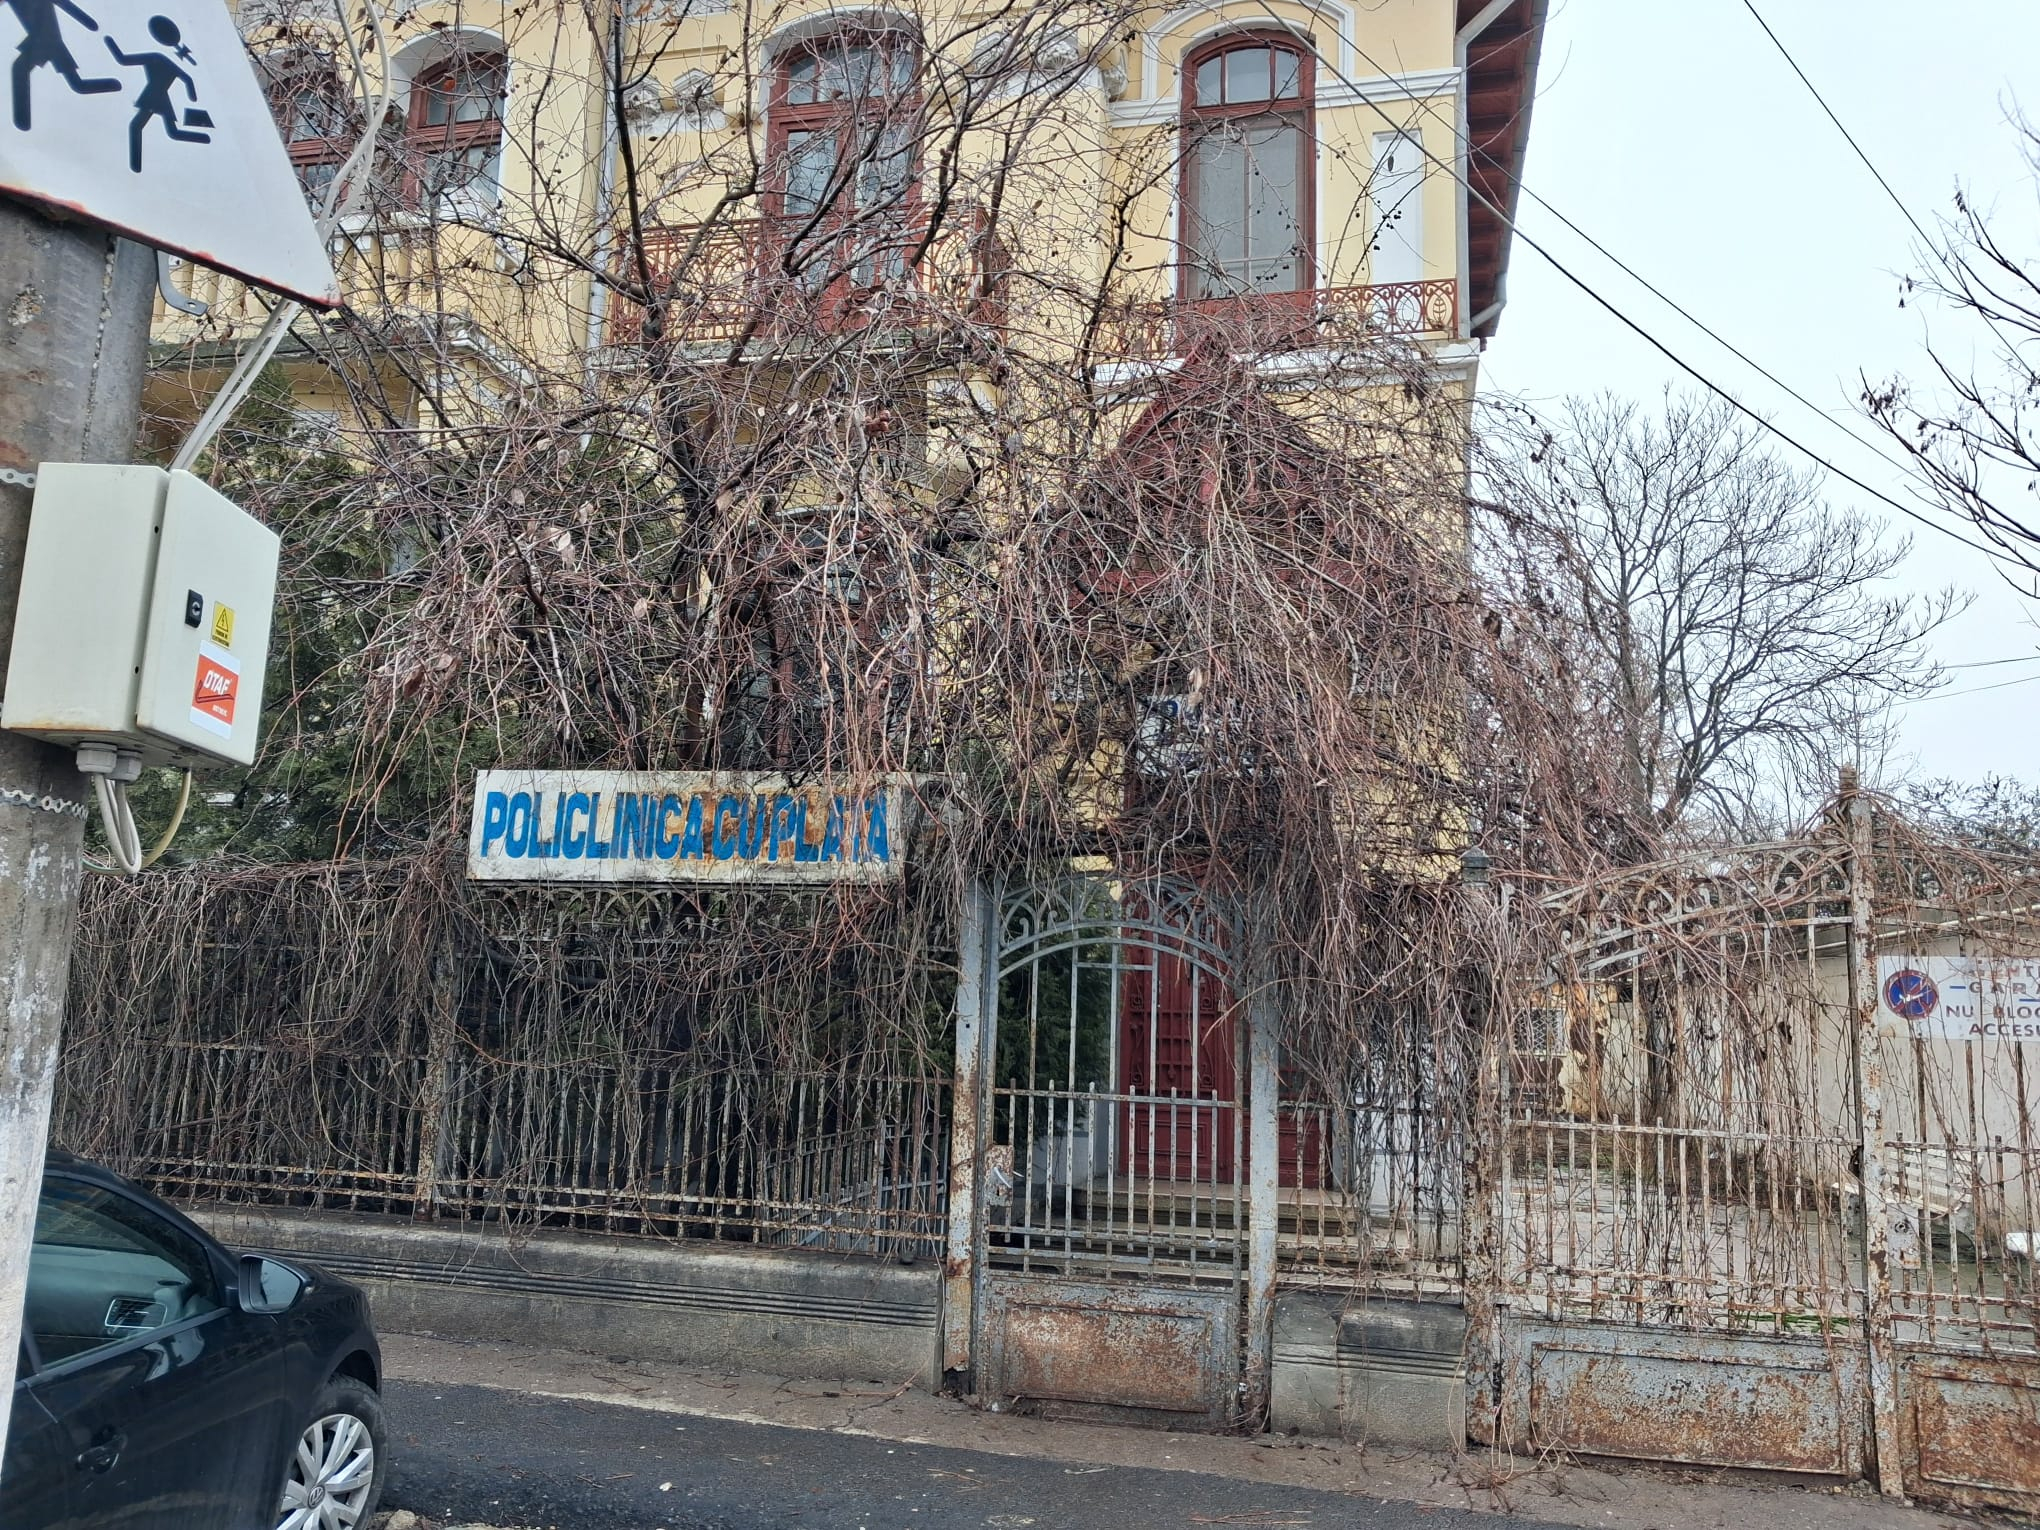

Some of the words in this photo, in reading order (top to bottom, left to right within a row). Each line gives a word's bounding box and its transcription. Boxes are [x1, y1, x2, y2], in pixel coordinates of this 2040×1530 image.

[481, 791, 704, 860] POLICLINICA
[712, 793, 767, 861] CU
[1969, 982, 2040, 995] GAR
[1946, 1005, 1974, 1019] NU
